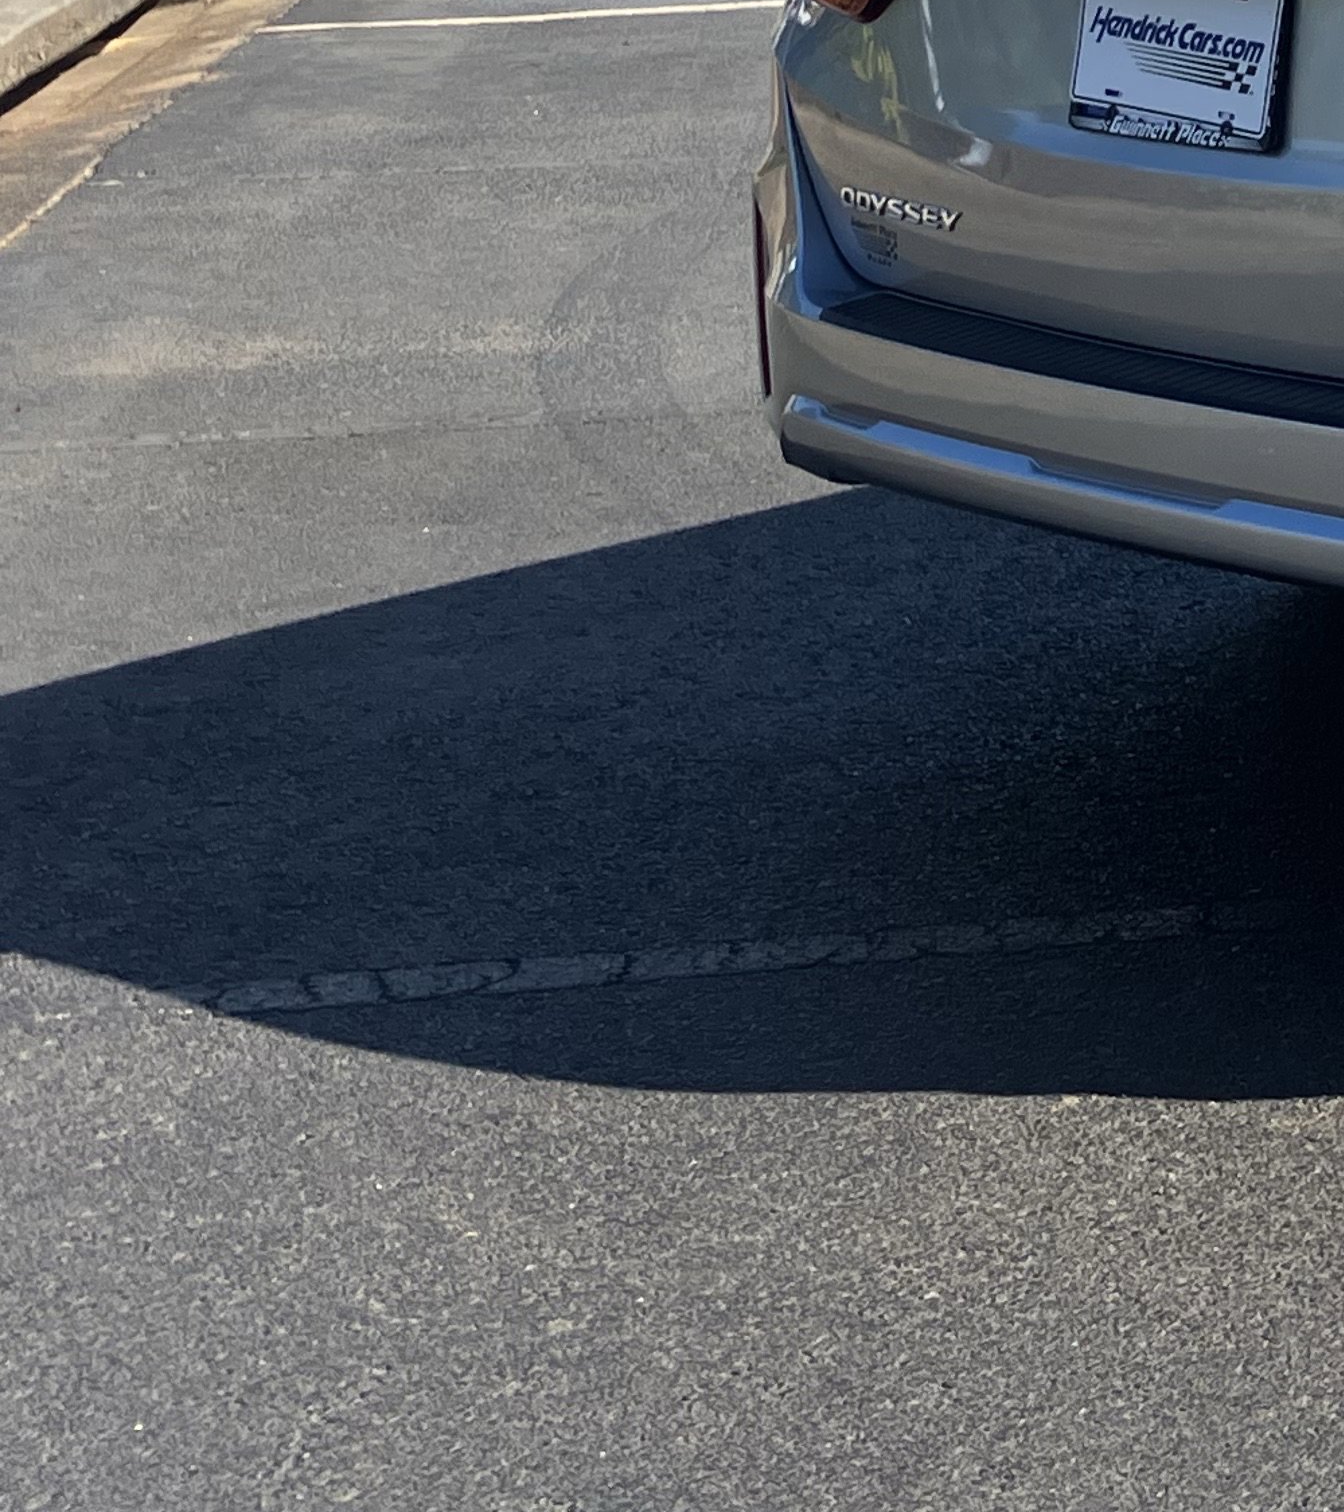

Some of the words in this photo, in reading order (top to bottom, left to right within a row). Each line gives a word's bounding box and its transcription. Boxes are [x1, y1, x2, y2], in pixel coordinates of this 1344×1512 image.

[1090, 6, 1265, 63] HendrickCars.com
[1109, 115, 1175, 141] Gwinnett
[1176, 122, 1220, 147] Place
[841, 187, 962, 231] ODYSSEY
